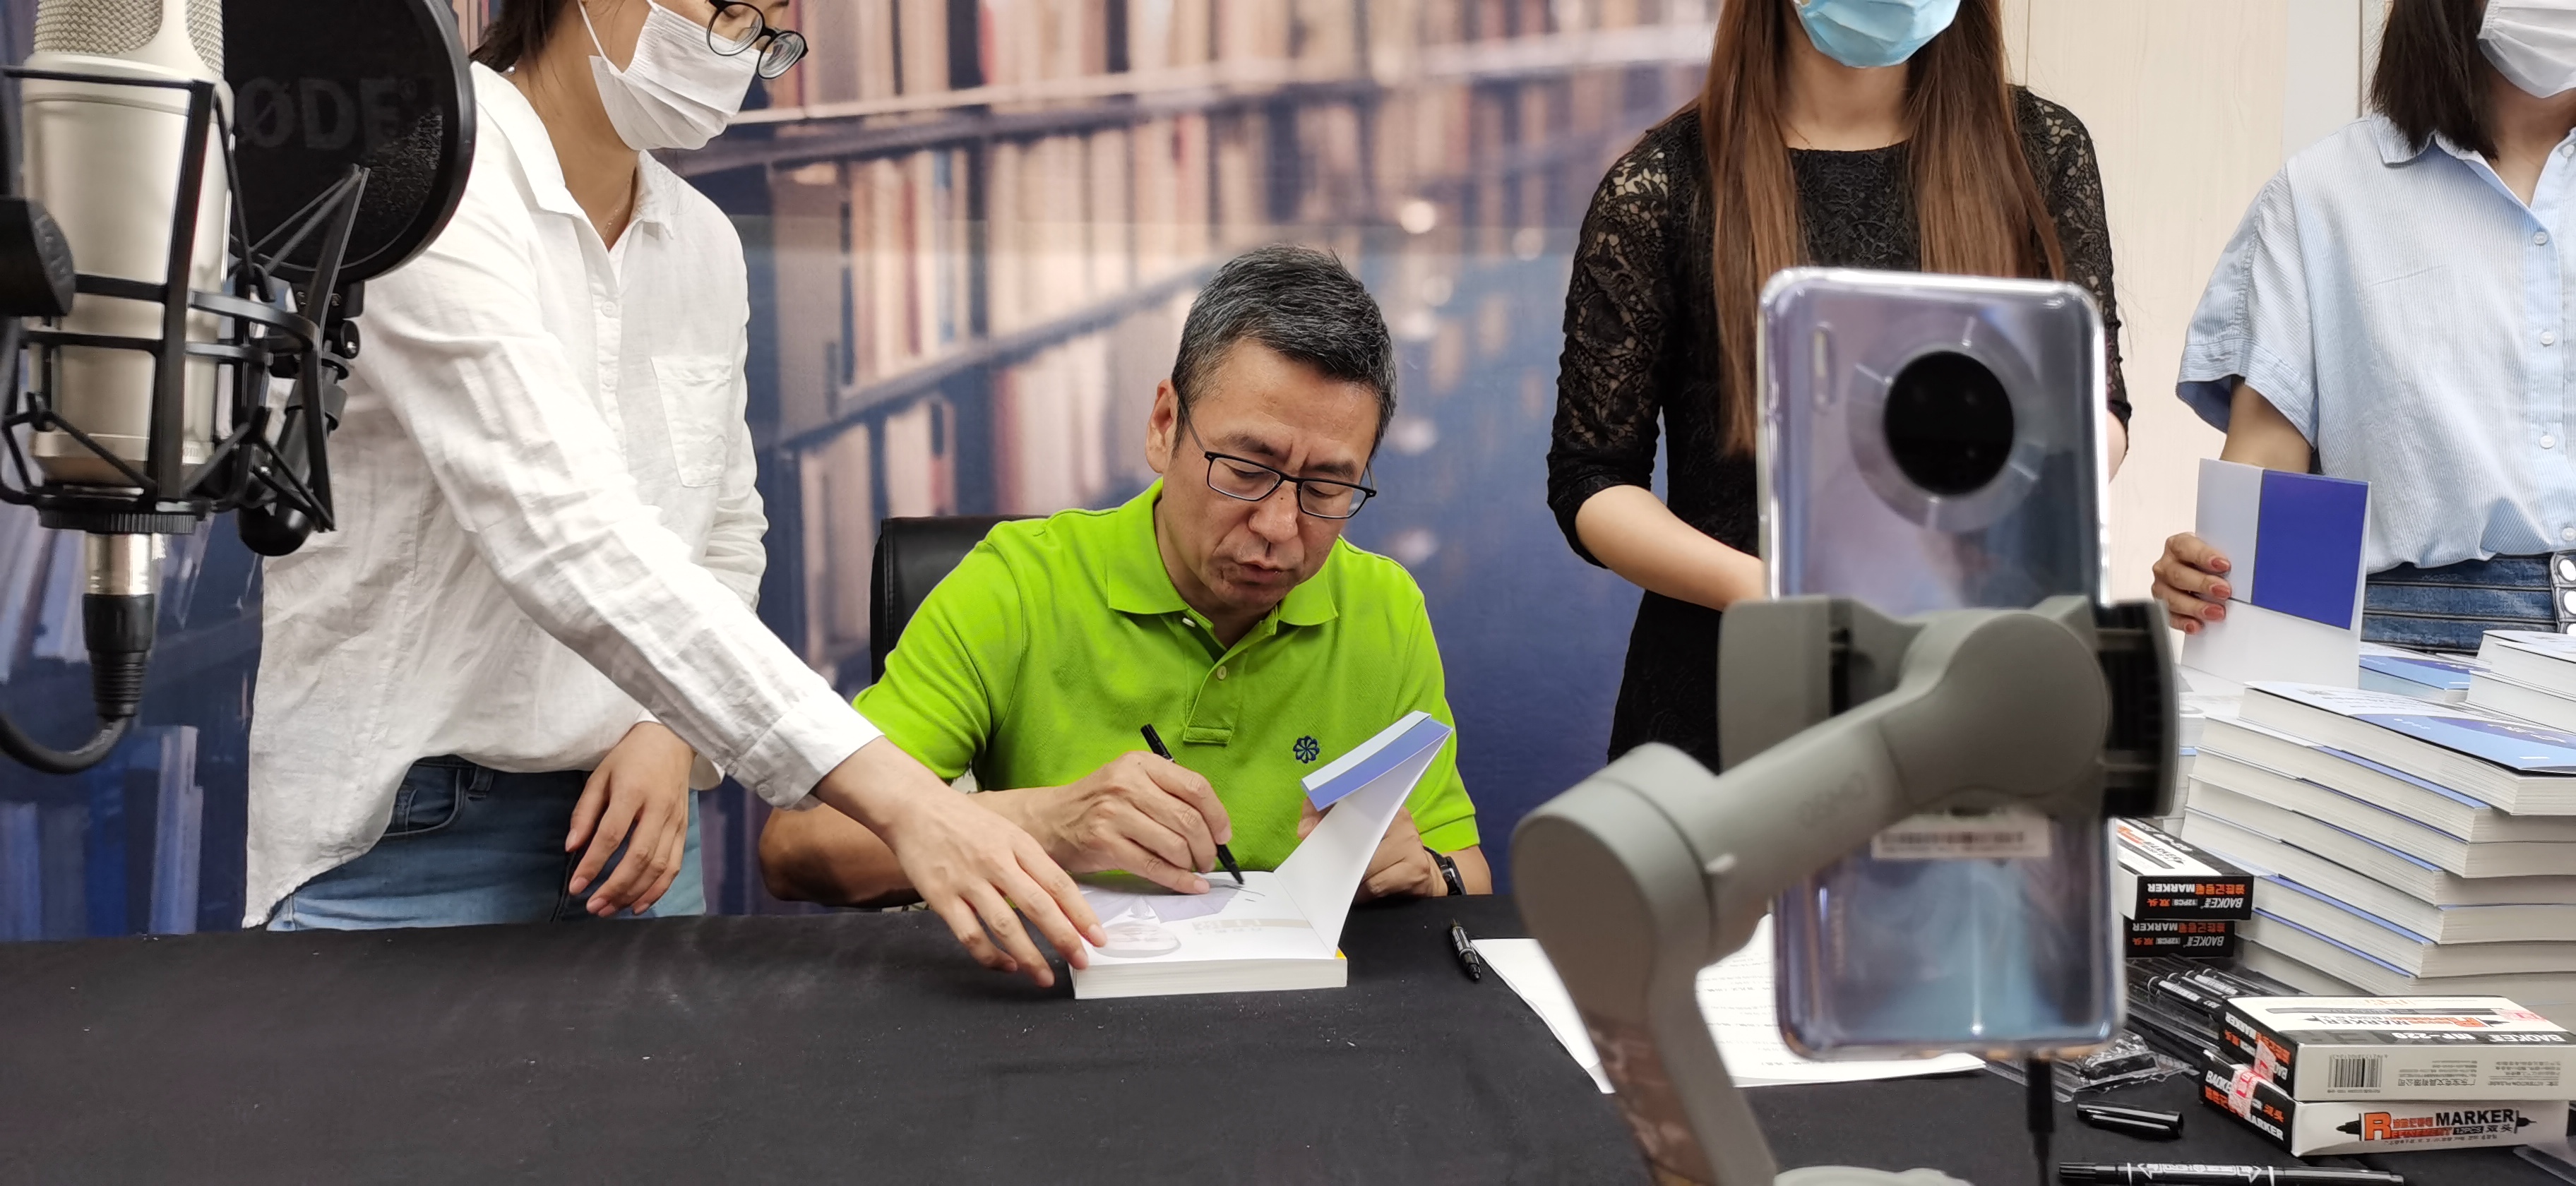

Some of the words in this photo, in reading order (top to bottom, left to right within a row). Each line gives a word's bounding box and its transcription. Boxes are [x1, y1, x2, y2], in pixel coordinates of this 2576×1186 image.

[237, 76, 400, 154] ØDE
[2147, 884, 2195, 892] MARKER
[2210, 897, 2243, 908] BAOKE
[2132, 923, 2178, 931] MARKER
[2192, 935, 2225, 947] BAOKE
[2498, 1034, 2567, 1042] BAOKE
[2435, 1108, 2515, 1126] MARKER
[2454, 1126, 2483, 1134] 12PCS
